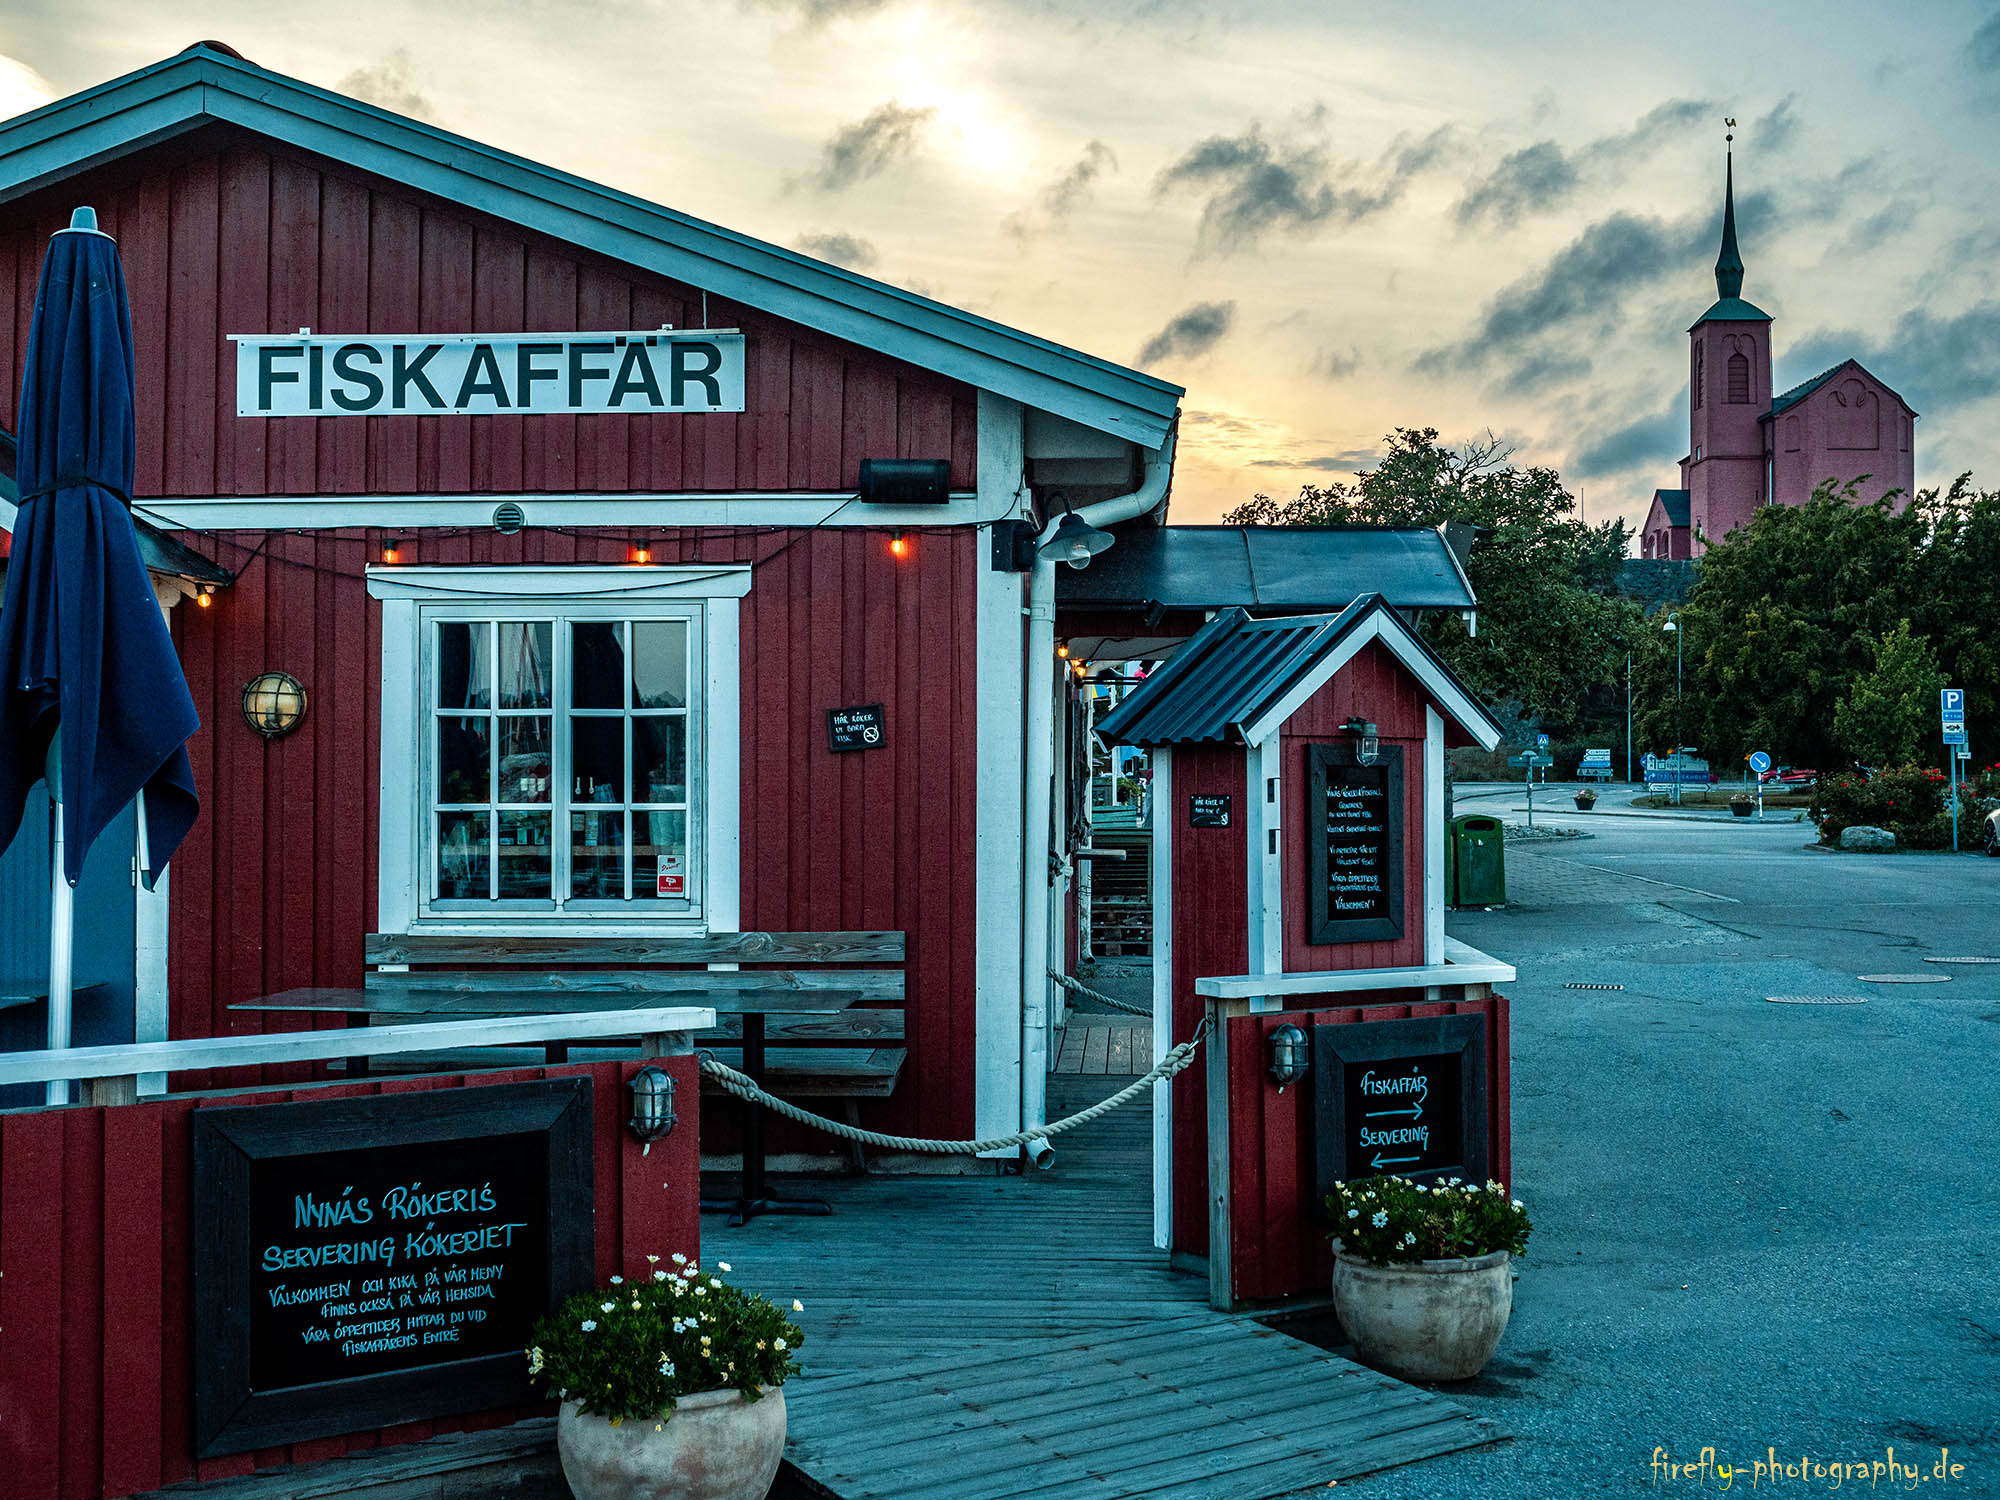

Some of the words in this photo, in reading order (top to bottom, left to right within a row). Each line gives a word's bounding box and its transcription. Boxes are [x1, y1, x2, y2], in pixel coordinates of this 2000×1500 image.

[258, 336, 722, 411] FISKAFFÄR
[1947, 692, 1959, 709] P
[1360, 1125, 1430, 1151] SERVERING
[295, 1185, 373, 1228] NYNÄS
[262, 1237, 395, 1271] SERVERING
[404, 1222, 528, 1259] KÖKERIET
[269, 1280, 351, 1308] VÄLKOMMEN
[362, 1278, 383, 1294] OCH
[389, 1275, 418, 1290] KIKA
[425, 1267, 440, 1287] PÅ
[444, 1263, 467, 1283] VÅR
[471, 1264, 504, 1281] MENY
[321, 1301, 357, 1318] FINNS
[360, 1291, 395, 1313] OCKSÅ
[400, 1290, 415, 1308] PÅ
[419, 1288, 441, 1305] VÅR
[445, 1283, 496, 1302] HEMSIDA
[334, 1318, 401, 1339] ÖPPETTIDER
[407, 1313, 445, 1330] HITTAR
[450, 1311, 465, 1324] DU
[467, 1309, 487, 1323] VID
[423, 1325, 460, 1345] ENTRÉ
